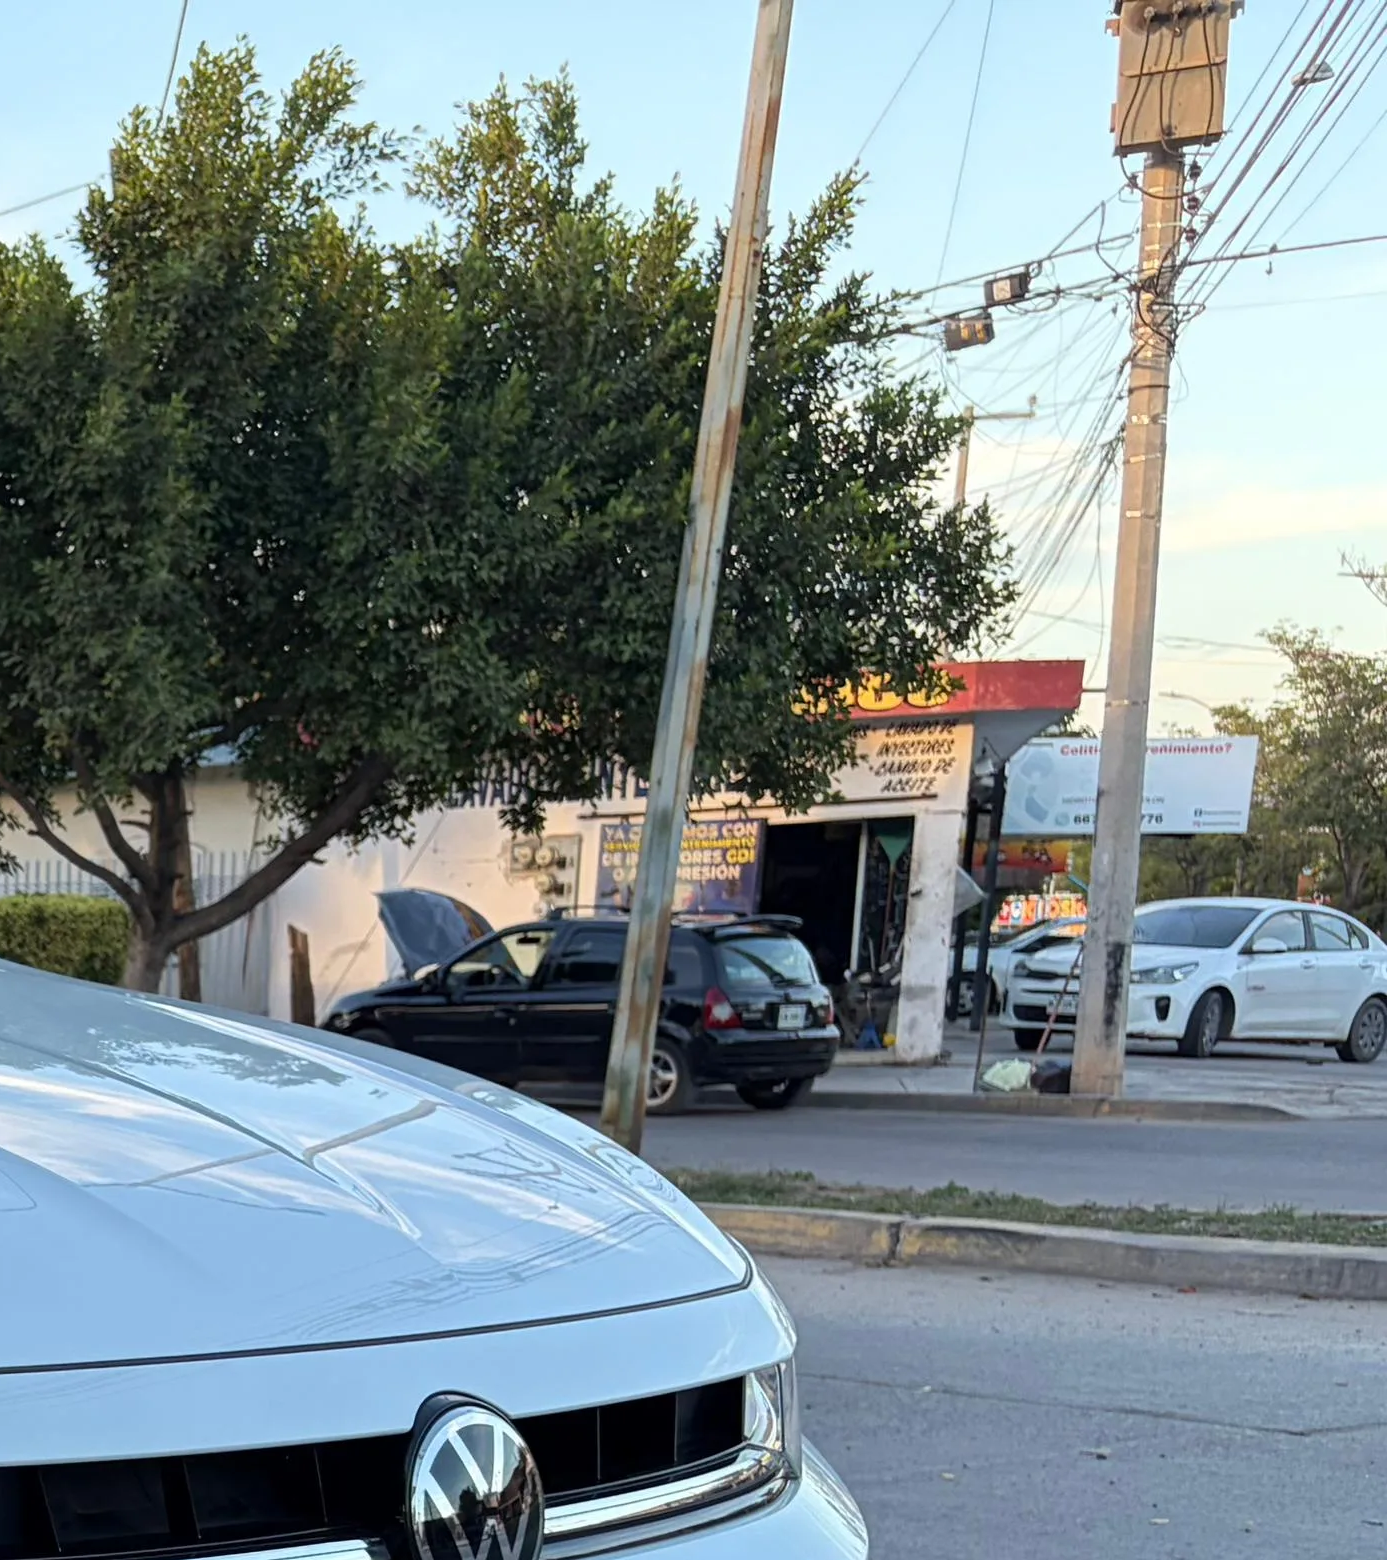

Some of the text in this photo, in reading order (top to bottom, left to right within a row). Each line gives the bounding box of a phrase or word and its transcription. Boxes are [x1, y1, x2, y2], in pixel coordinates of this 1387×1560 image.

[881, 777, 936, 793] ACEITE
[605, 827, 625, 841] YA
[722, 821, 759, 839] CON
[727, 847, 756, 864] GDI
